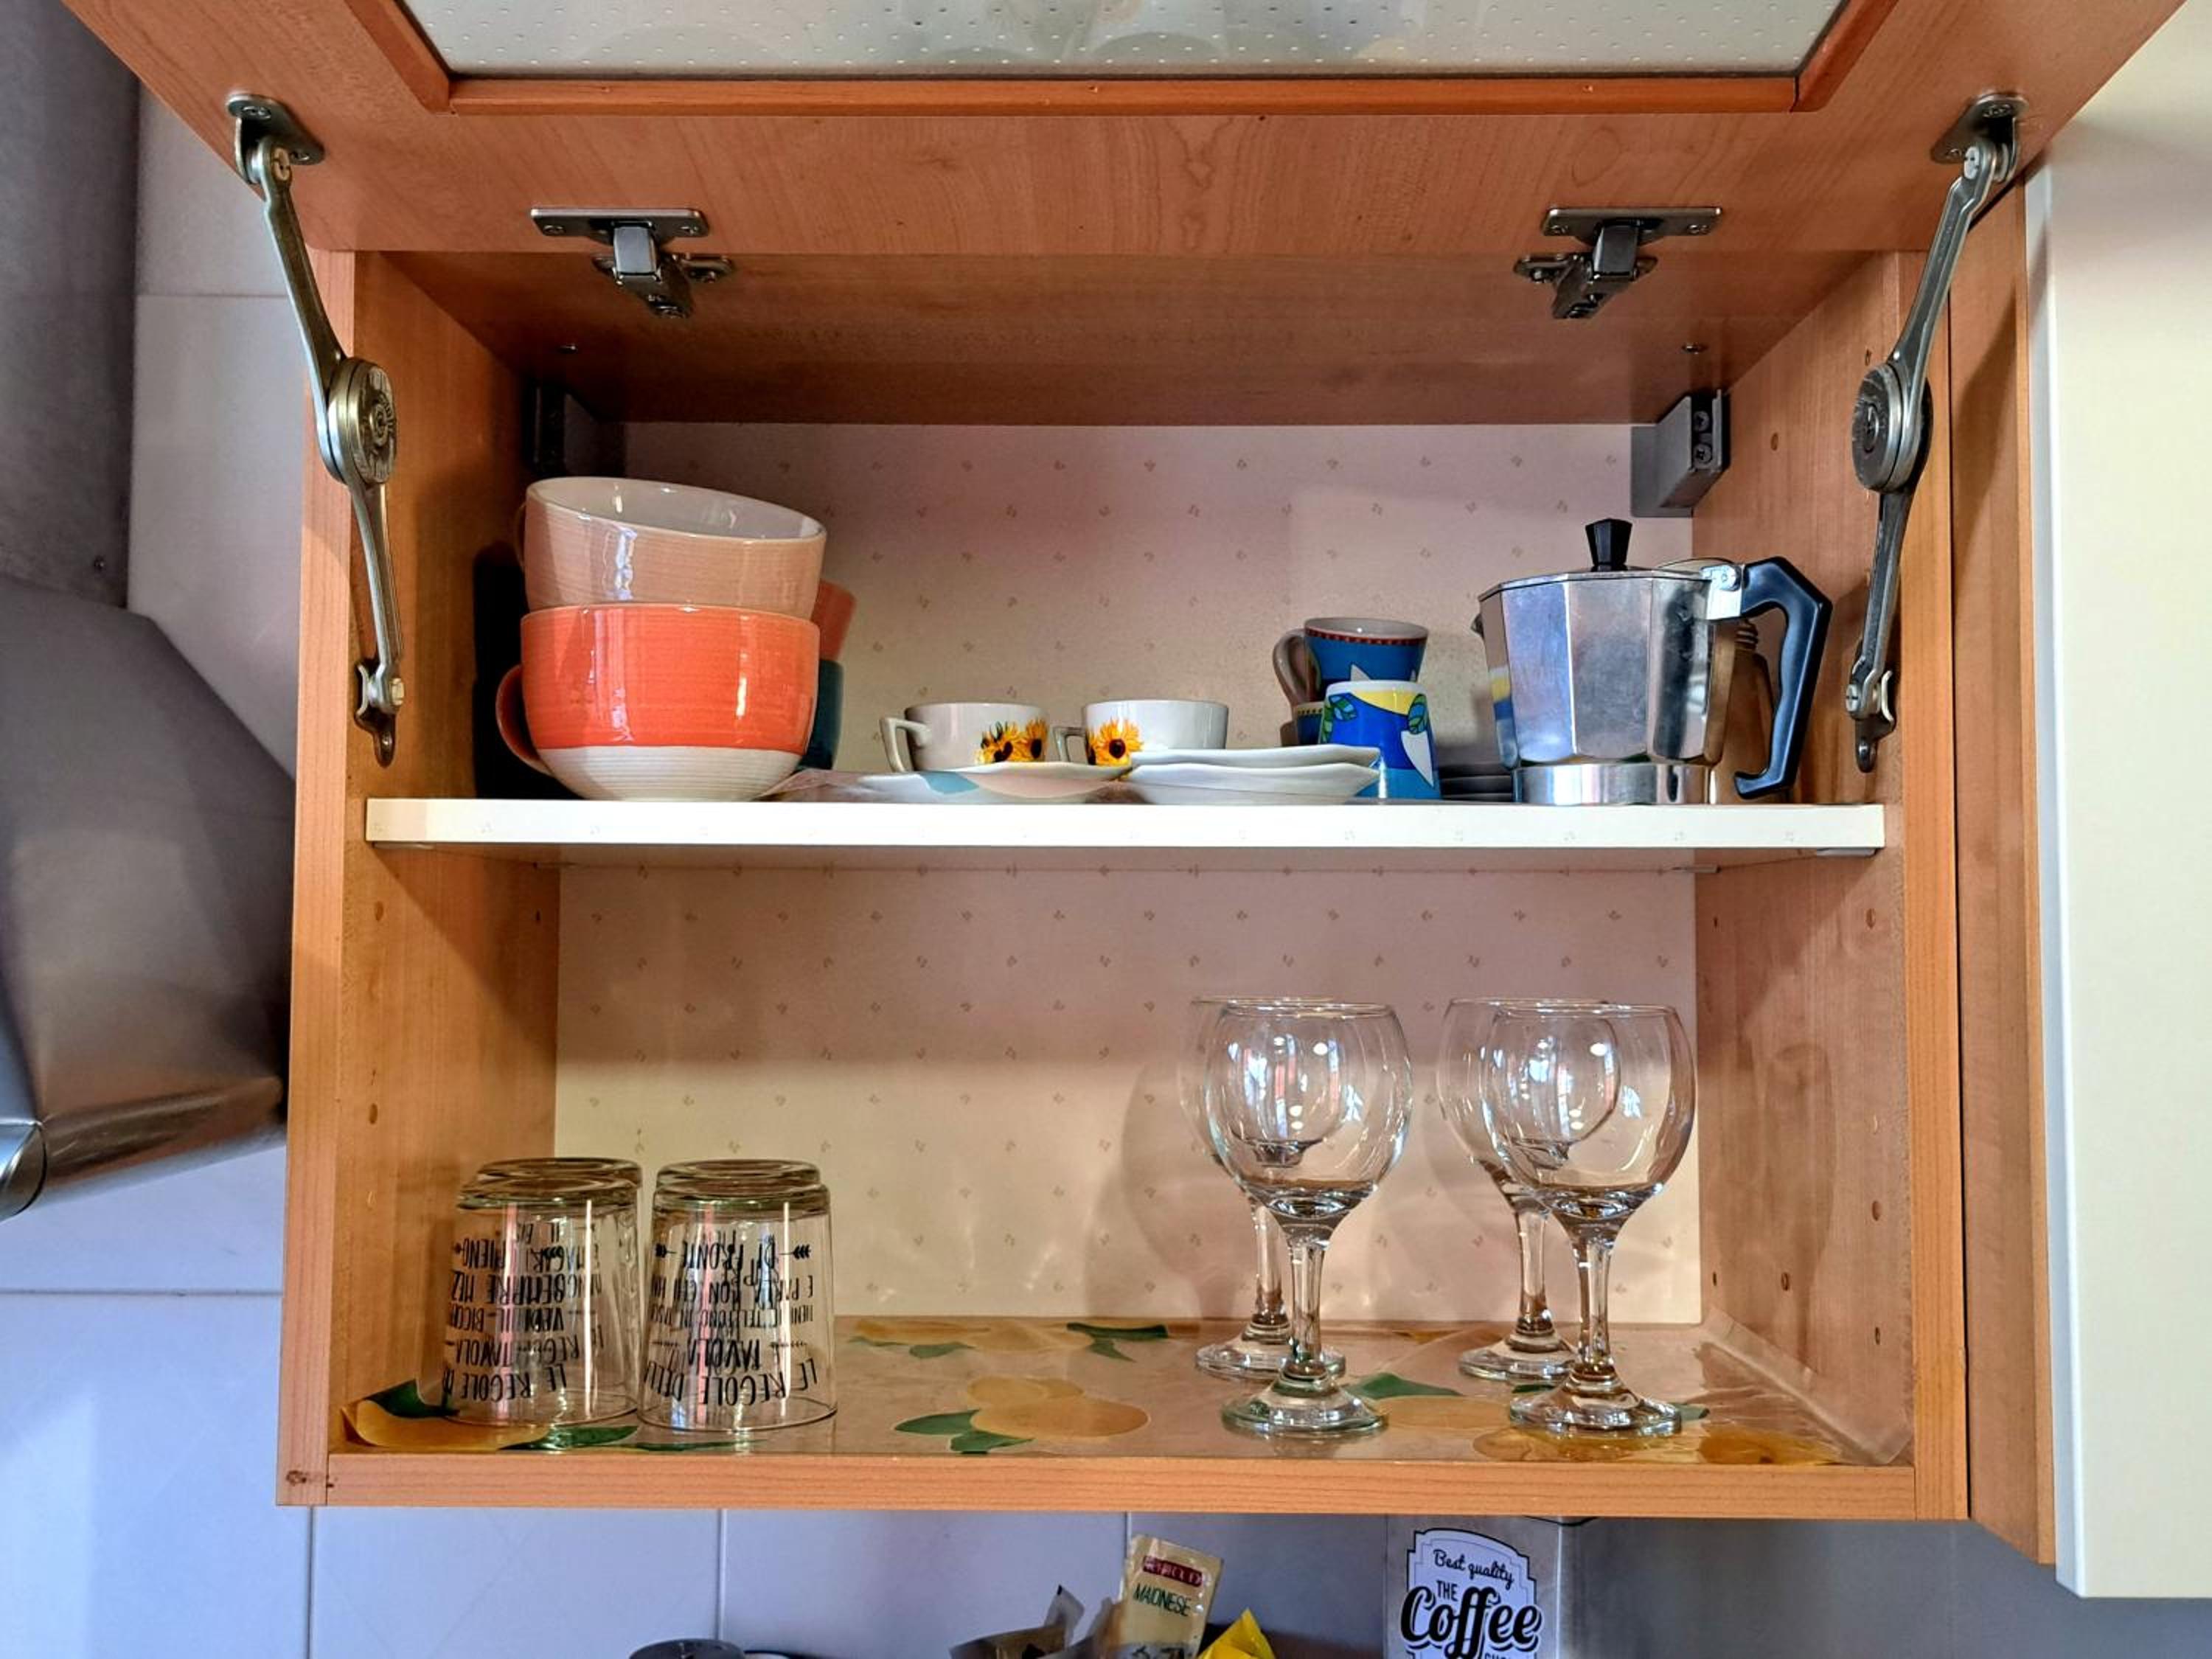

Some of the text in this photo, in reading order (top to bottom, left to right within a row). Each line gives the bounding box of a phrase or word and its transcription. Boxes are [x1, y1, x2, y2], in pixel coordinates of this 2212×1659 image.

[487, 1273, 566, 1305] SEMPRE
[456, 1338, 513, 1367] TAVOLA
[461, 1371, 532, 1402] REGOLE
[548, 1365, 567, 1392] LE
[699, 1371, 787, 1405] REGOLE
[790, 1357, 818, 1392] LE
[1433, 1549, 1515, 1590] Best quality
[1436, 1580, 1458, 1601] THE
[1401, 1585, 1543, 1659] Coffee
